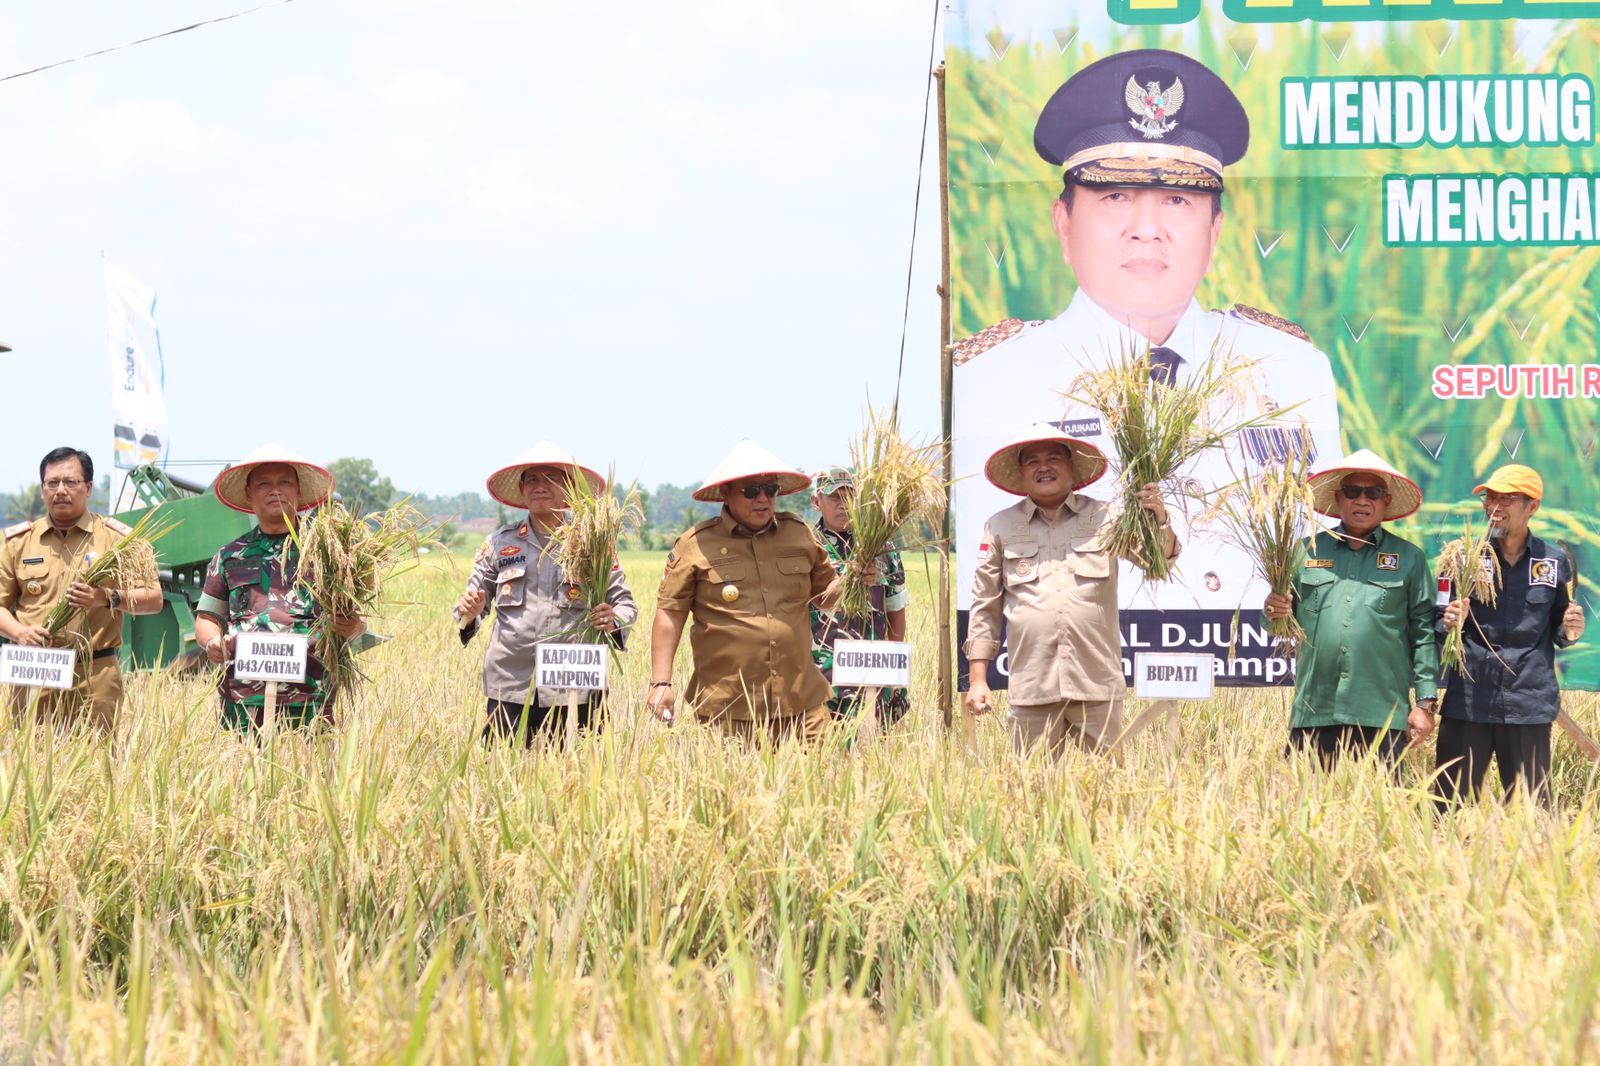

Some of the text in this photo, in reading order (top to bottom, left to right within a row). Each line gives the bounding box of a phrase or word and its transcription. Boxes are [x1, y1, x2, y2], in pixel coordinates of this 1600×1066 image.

[1284, 78, 1591, 144] MENDUKUNG
[1386, 177, 1600, 242] MENGHA
[124, 346, 135, 391] Endure
[1433, 365, 1575, 397] SEPUTIH
[1064, 422, 1100, 434] DJUNAIDI
[1161, 623, 1296, 648] DJUN
[6, 649, 35, 662] KADIS
[251, 642, 294, 657] DANREM
[542, 649, 601, 665] KAPOLDA
[237, 659, 301, 674] 043/GATAM
[836, 651, 907, 669] GUBERNUR
[10, 665, 61, 681] PROVINSI
[542, 670, 600, 686] LAMPUNG
[1146, 665, 1198, 682] BUPATI
